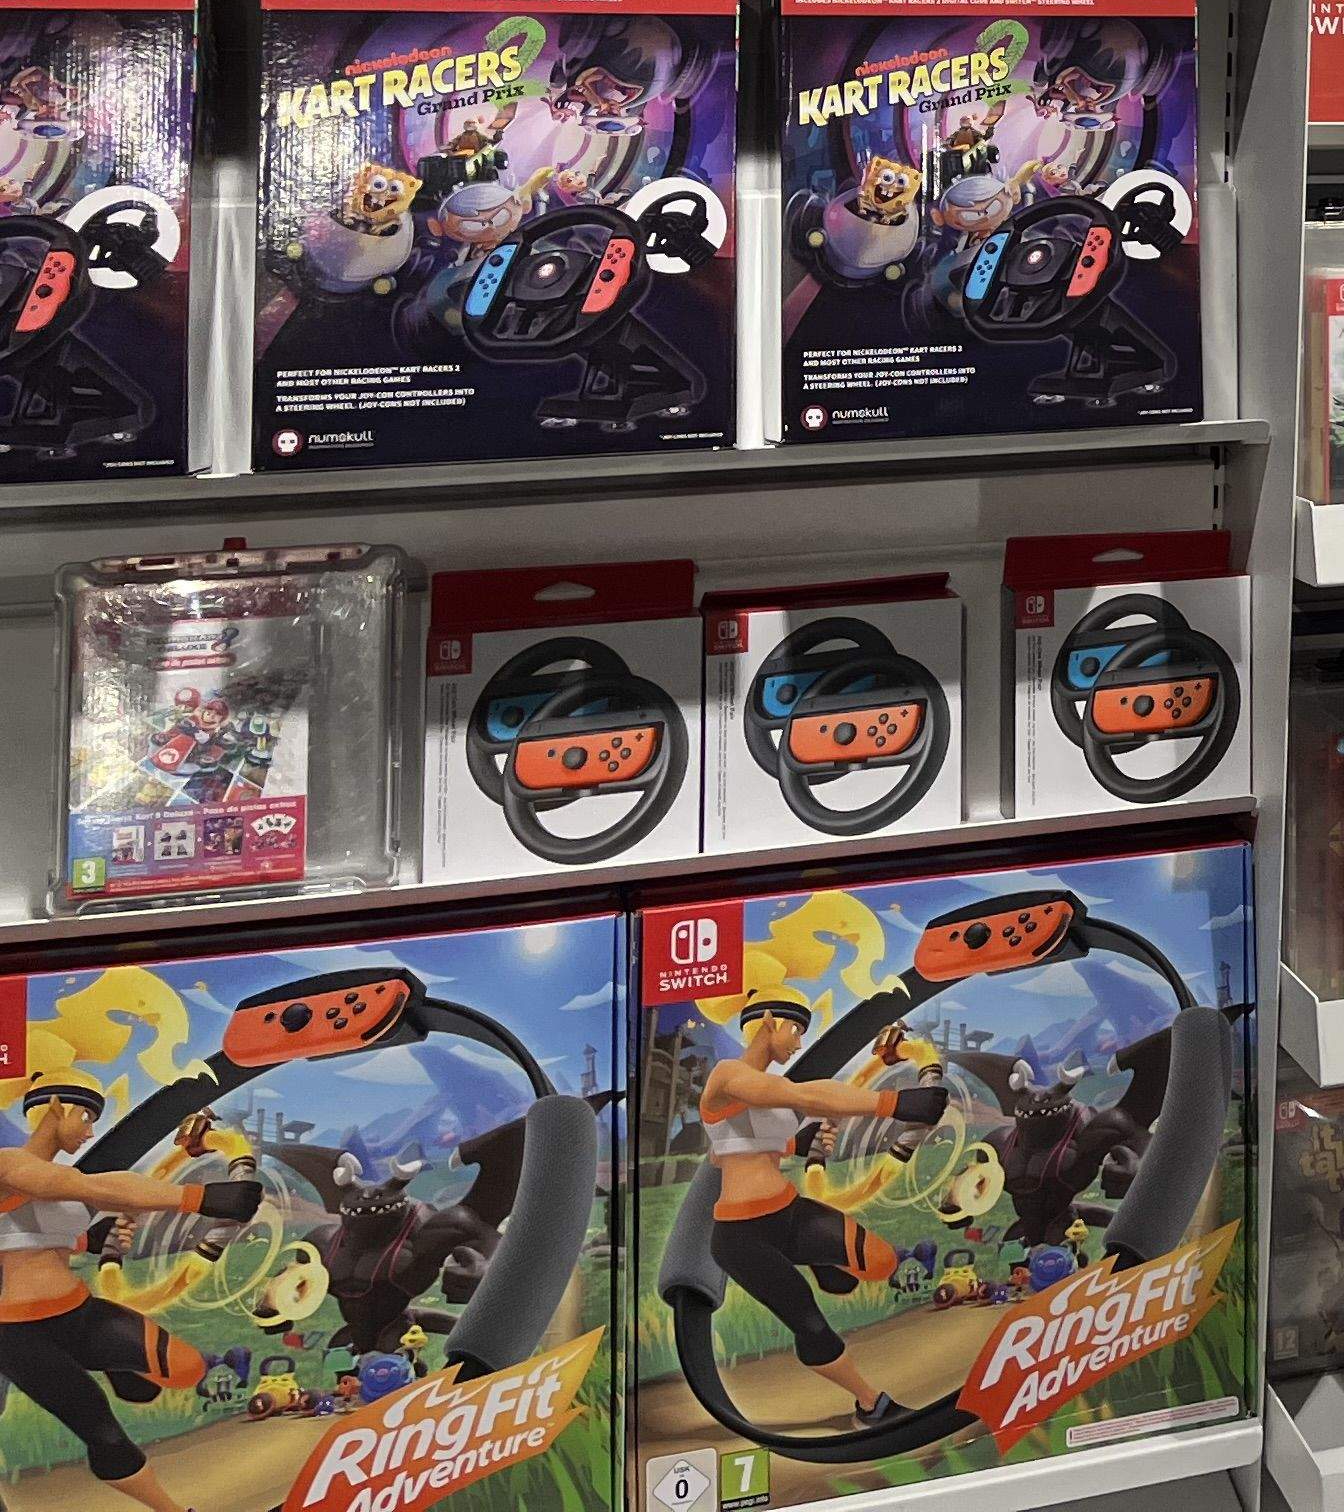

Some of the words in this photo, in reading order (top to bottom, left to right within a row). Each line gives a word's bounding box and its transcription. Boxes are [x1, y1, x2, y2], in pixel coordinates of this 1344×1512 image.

[277, 76, 376, 128] KART
[384, 45, 523, 107] RACERS
[416, 95, 481, 117] Grand
[482, 82, 525, 104] Prix
[799, 71, 884, 127] KART
[888, 46, 1010, 106] RACERS
[918, 90, 972, 114] Grand
[973, 83, 1013, 104] Prix
[833, 407, 889, 420] numskull
[308, 430, 373, 444] numskull
[83, 861, 97, 884] 3
[660, 963, 728, 979] NINTENDO
[660, 972, 729, 992] SWITCH
[1000, 1314, 1191, 1429] Adventure
[733, 1455, 750, 1492] 7
[676, 1479, 688, 1500] 0
